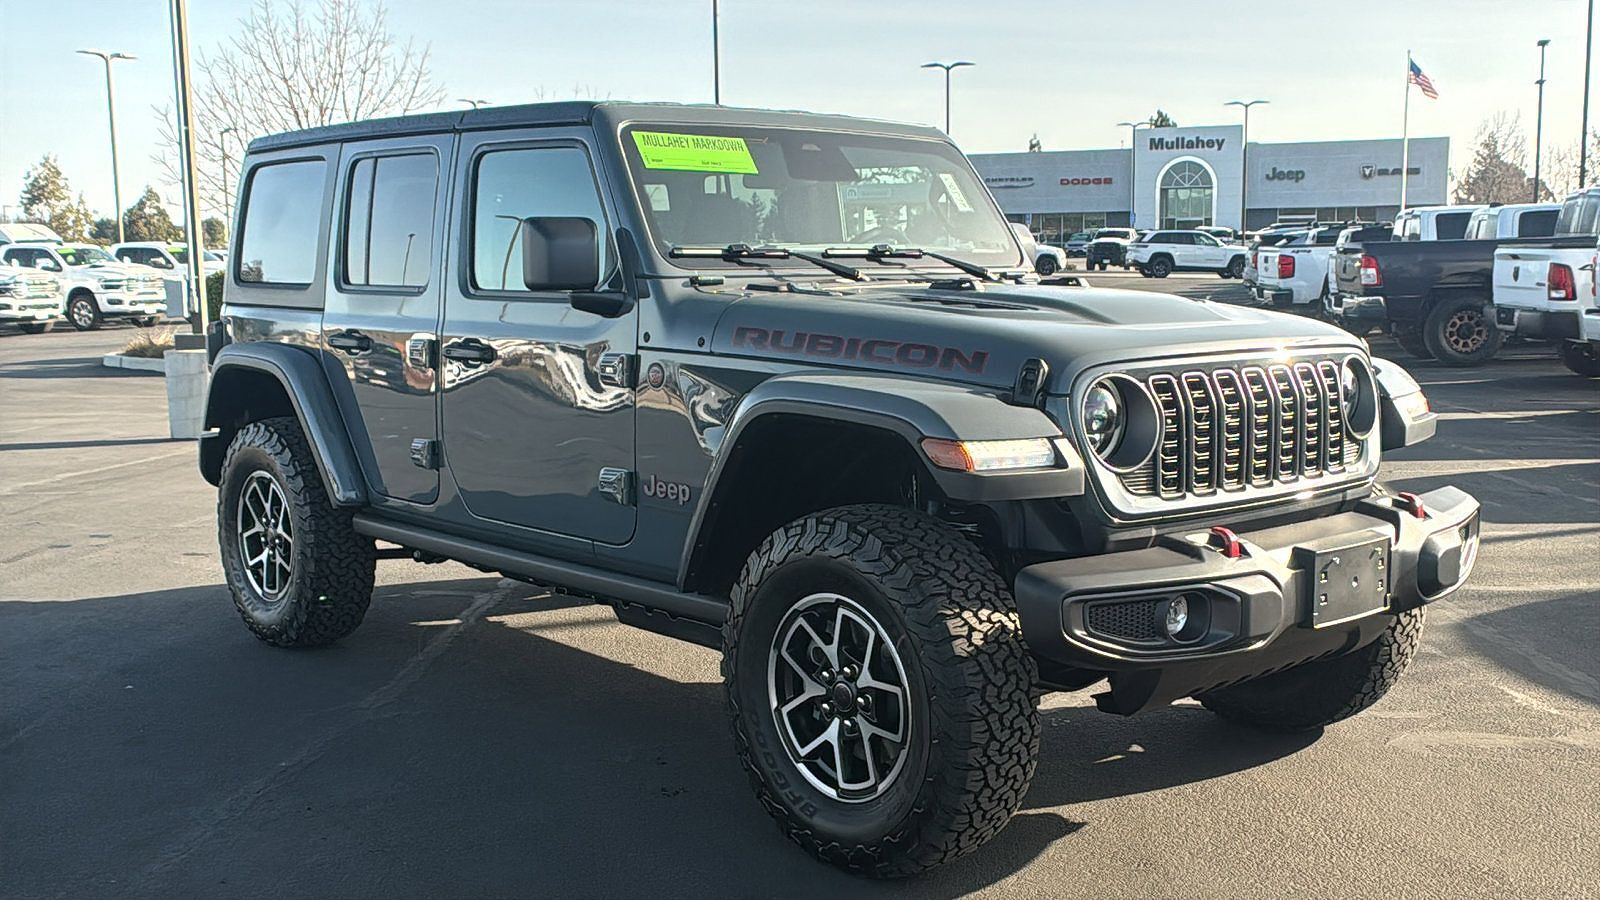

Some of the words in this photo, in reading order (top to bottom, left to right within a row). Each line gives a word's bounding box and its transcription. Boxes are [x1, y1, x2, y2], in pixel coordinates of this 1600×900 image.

[641, 134, 690, 149] MULLAHEY
[691, 138, 745, 152] MARKDOWN
[1149, 136, 1226, 151] Mullahey
[1059, 177, 1113, 186] DODGE
[1265, 166, 1306, 183] Jeep
[732, 326, 990, 374] RUBICON
[643, 474, 691, 506] Jeep
